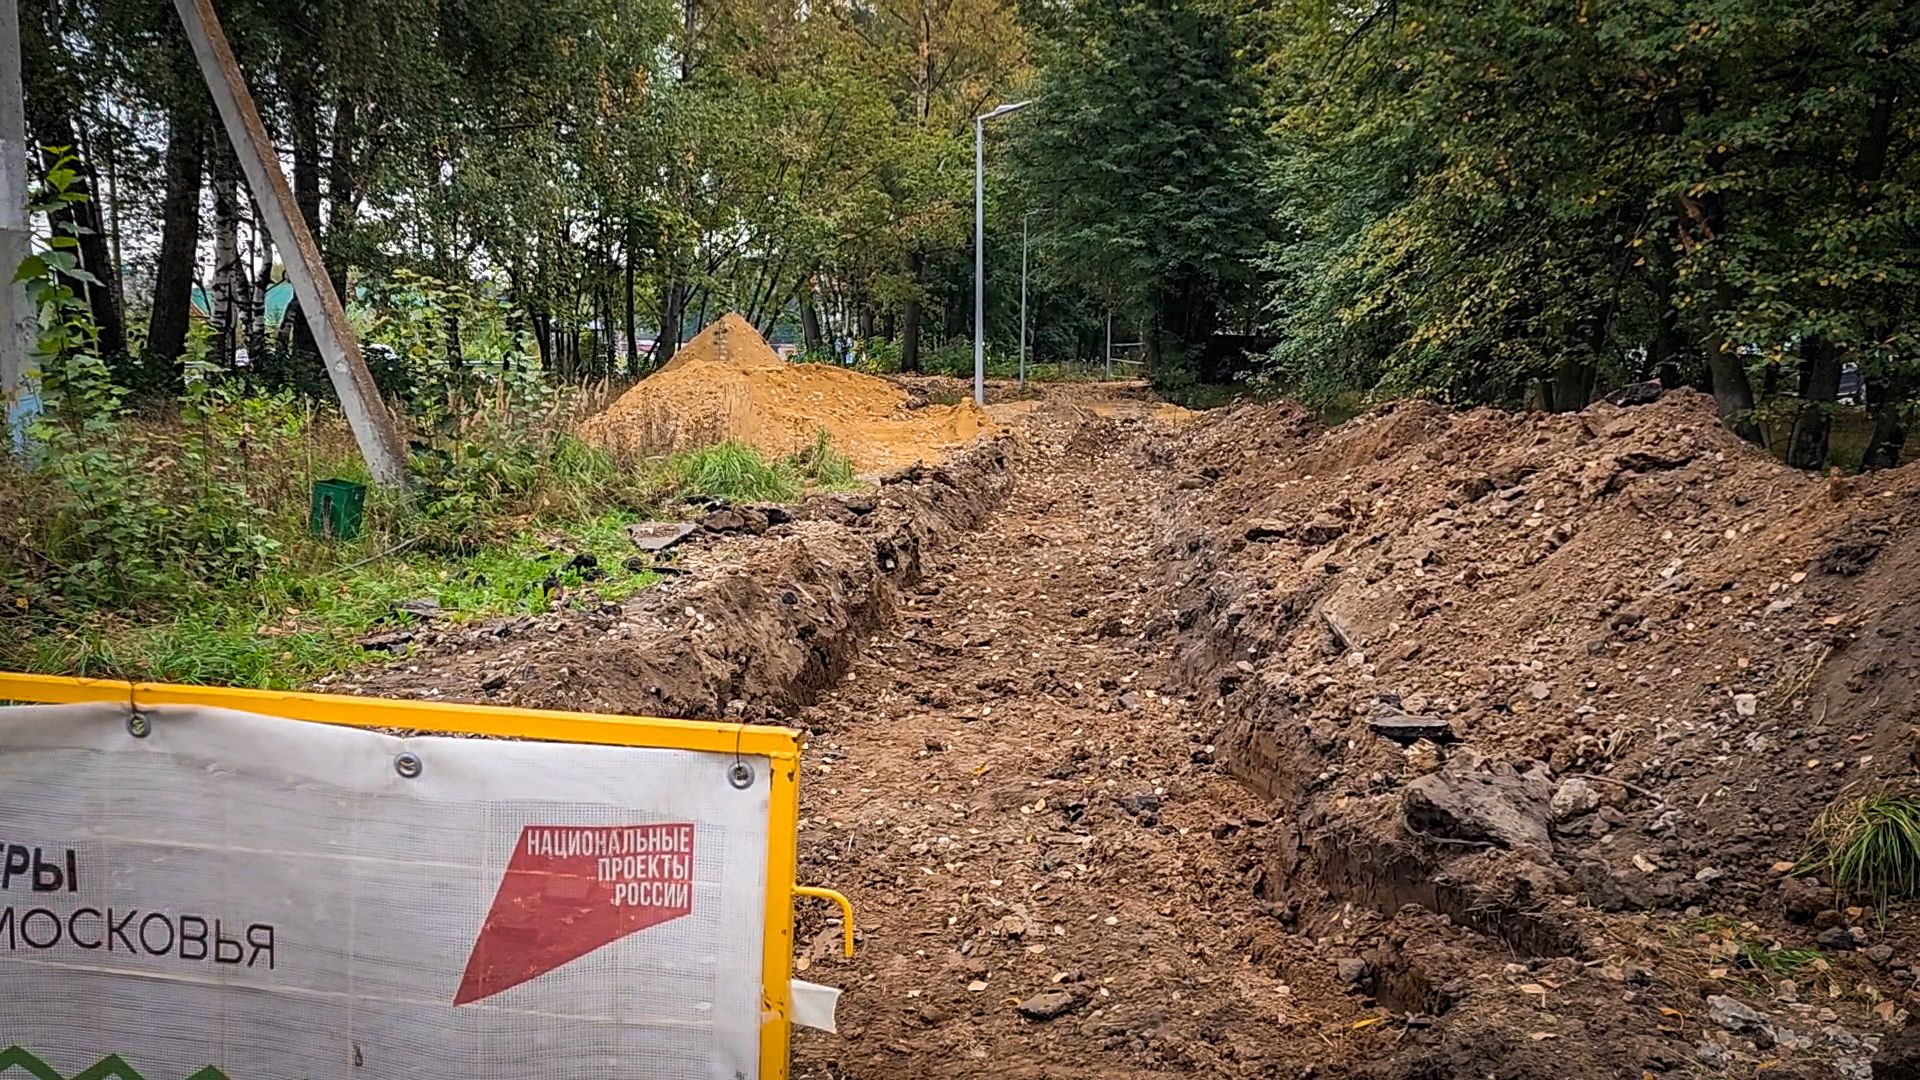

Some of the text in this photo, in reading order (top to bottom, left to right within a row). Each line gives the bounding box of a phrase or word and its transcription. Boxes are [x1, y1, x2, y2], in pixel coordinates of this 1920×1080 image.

[526, 826, 690, 859] НАЦИОНАЛЬНЫЕ
[0, 843, 78, 893] РЫ
[597, 854, 689, 881] ПРОЕКТЫ
[614, 882, 688, 908] РОССИИ
